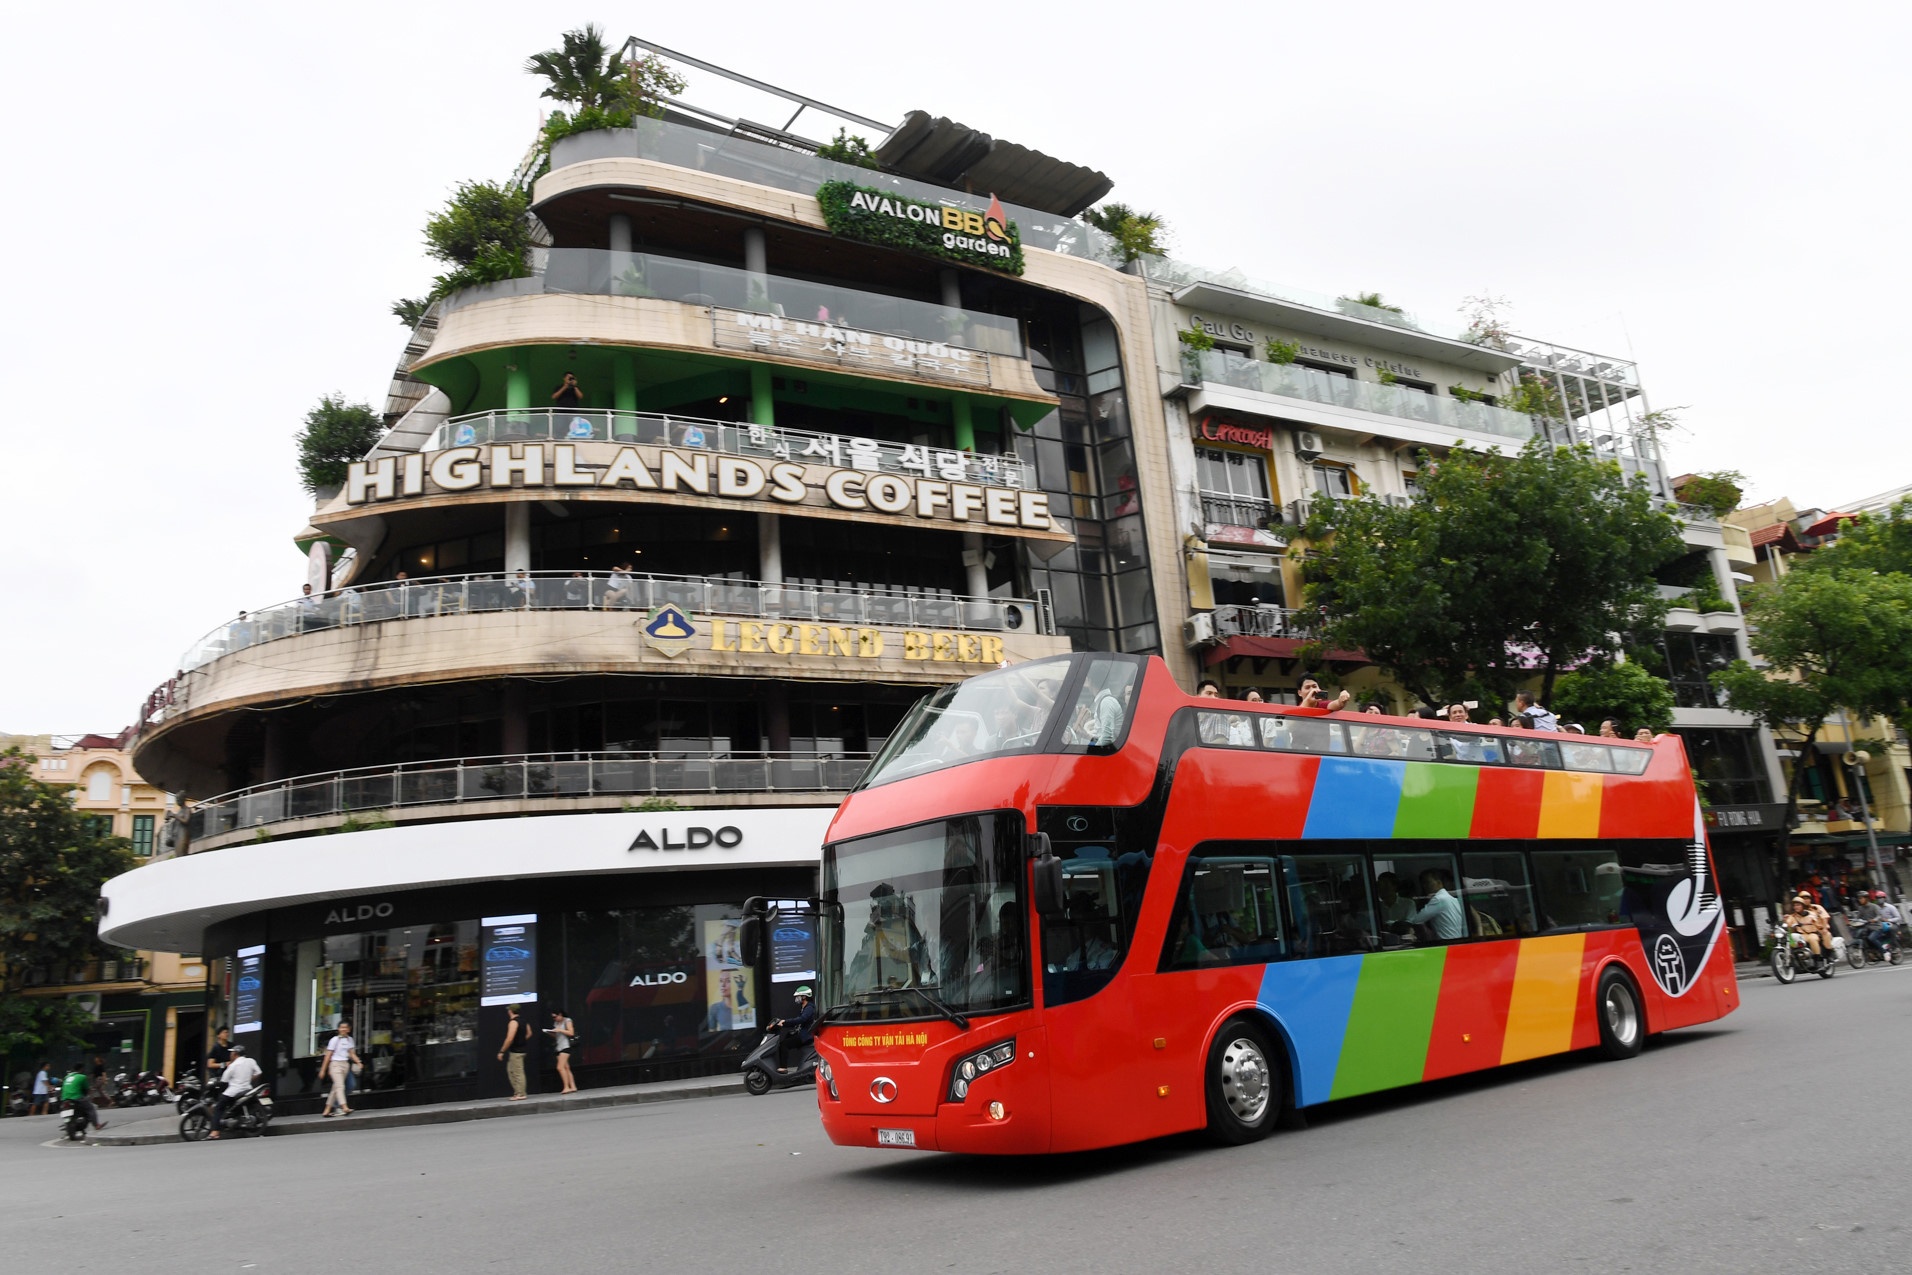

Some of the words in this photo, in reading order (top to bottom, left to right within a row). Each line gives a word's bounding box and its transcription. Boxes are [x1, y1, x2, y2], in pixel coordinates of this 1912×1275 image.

[850, 191, 940, 226] AVALON
[942, 233, 1011, 258] garden
[1190, 314, 1226, 337] Cau
[1230, 322, 1256, 342] Go
[349, 443, 808, 503] HIGHLANDS
[825, 469, 1051, 529] COFFEE
[710, 619, 884, 658] LEGEND
[904, 631, 1005, 664] BEER
[628, 825, 743, 851] ALDO
[324, 902, 394, 924] ALDO
[629, 971, 688, 987] ALDO
[874, 1036, 881, 1046] TY
